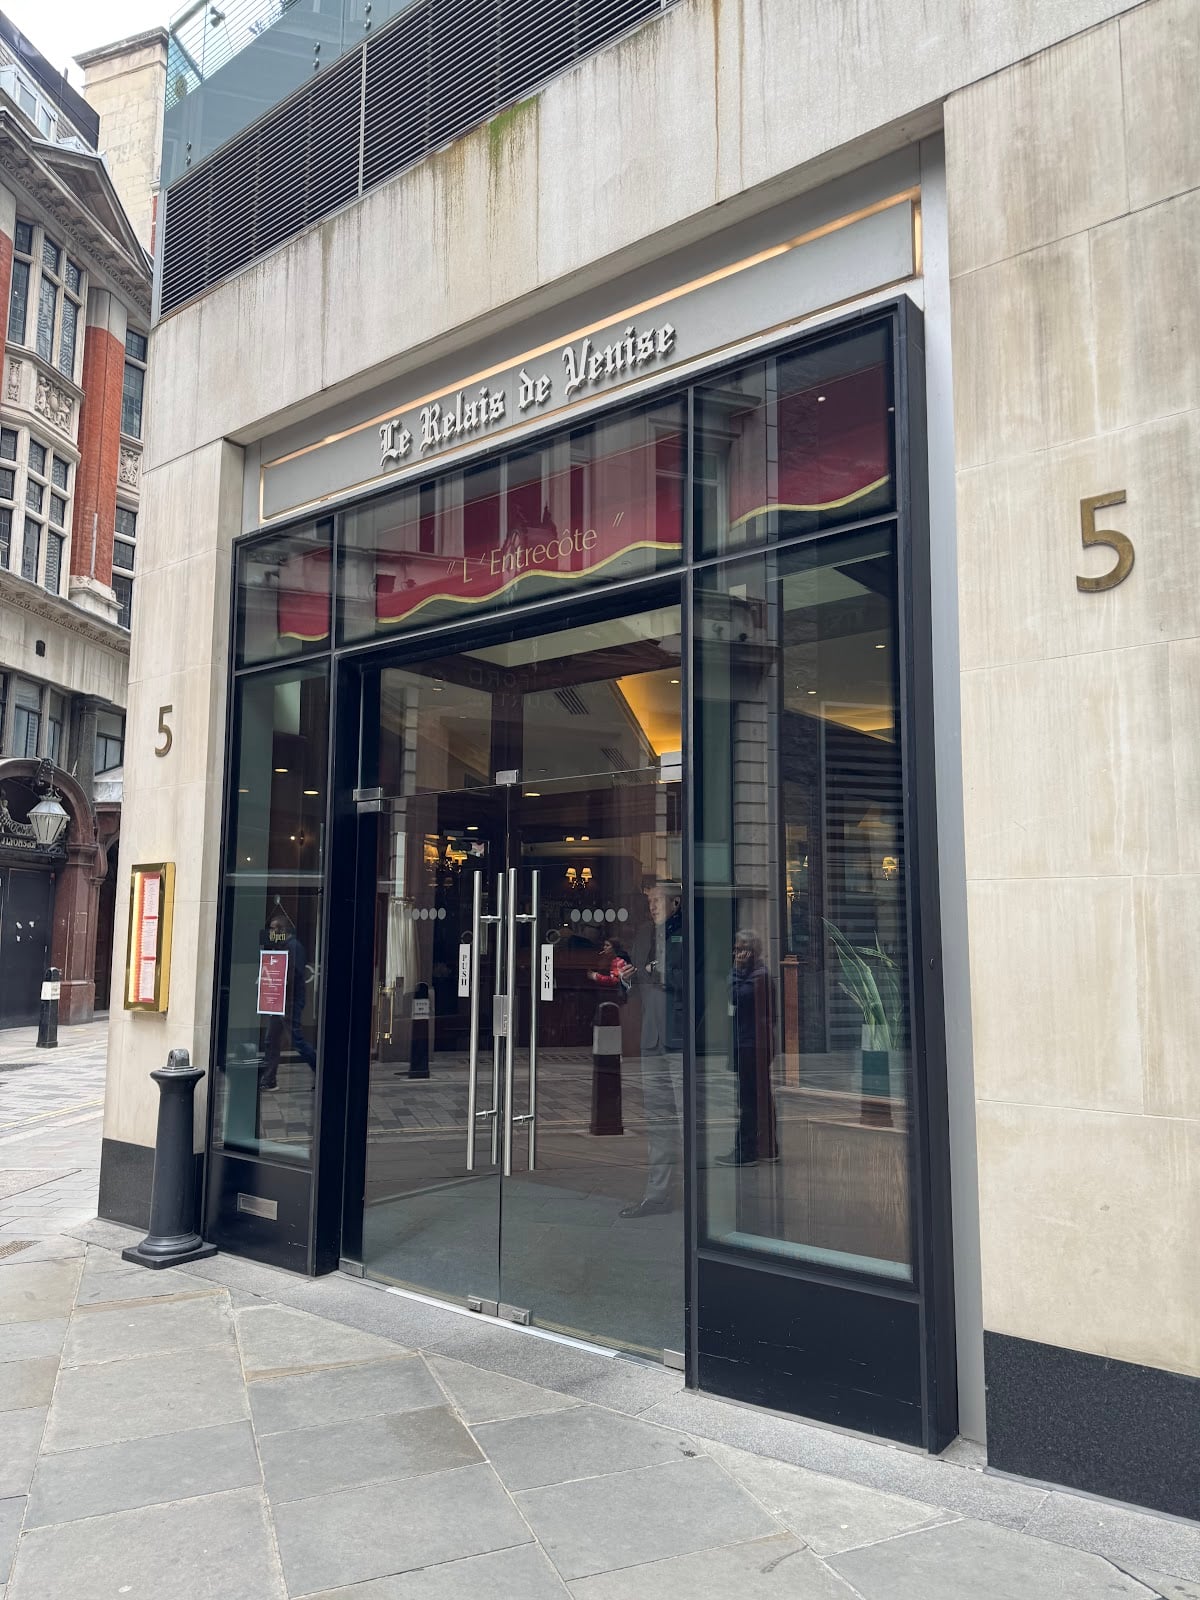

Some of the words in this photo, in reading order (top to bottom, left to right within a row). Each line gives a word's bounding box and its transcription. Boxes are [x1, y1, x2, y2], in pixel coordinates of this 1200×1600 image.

[380, 419, 411, 467] Le
[419, 386, 505, 452] Relais
[518, 368, 552, 409] de
[562, 322, 676, 395] Venise
[1076, 489, 1135, 593] 5
[154, 704, 173, 758] 5
